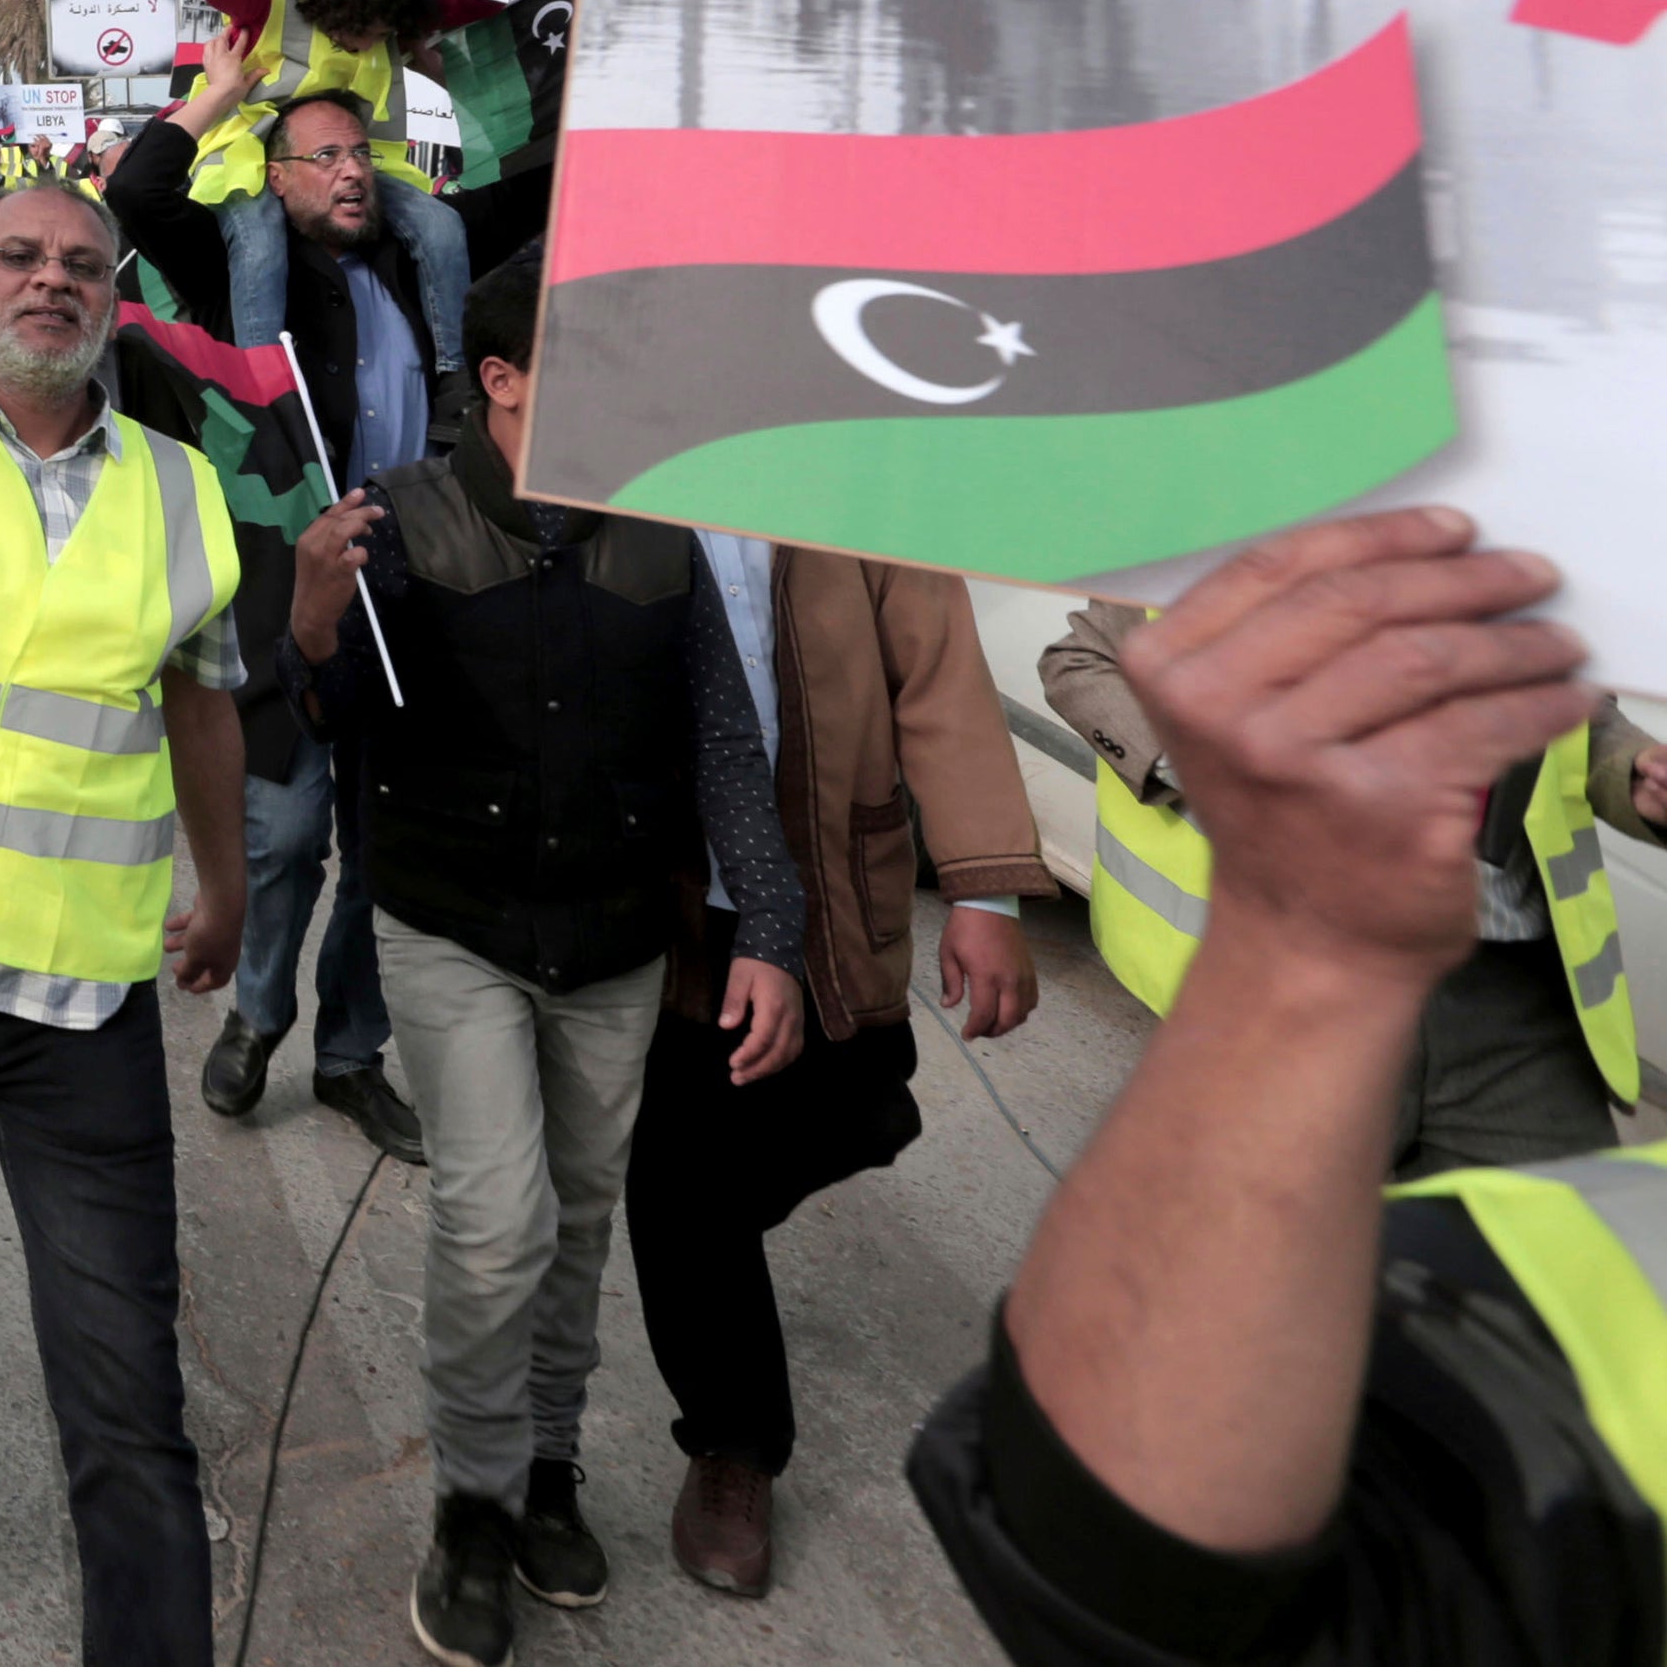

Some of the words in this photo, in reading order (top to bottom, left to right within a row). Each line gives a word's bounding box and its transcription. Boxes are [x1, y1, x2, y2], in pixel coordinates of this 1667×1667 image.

[22, 88, 41, 104] UN
[45, 90, 77, 104] STOP
[36, 115, 66, 127] LIBYA
